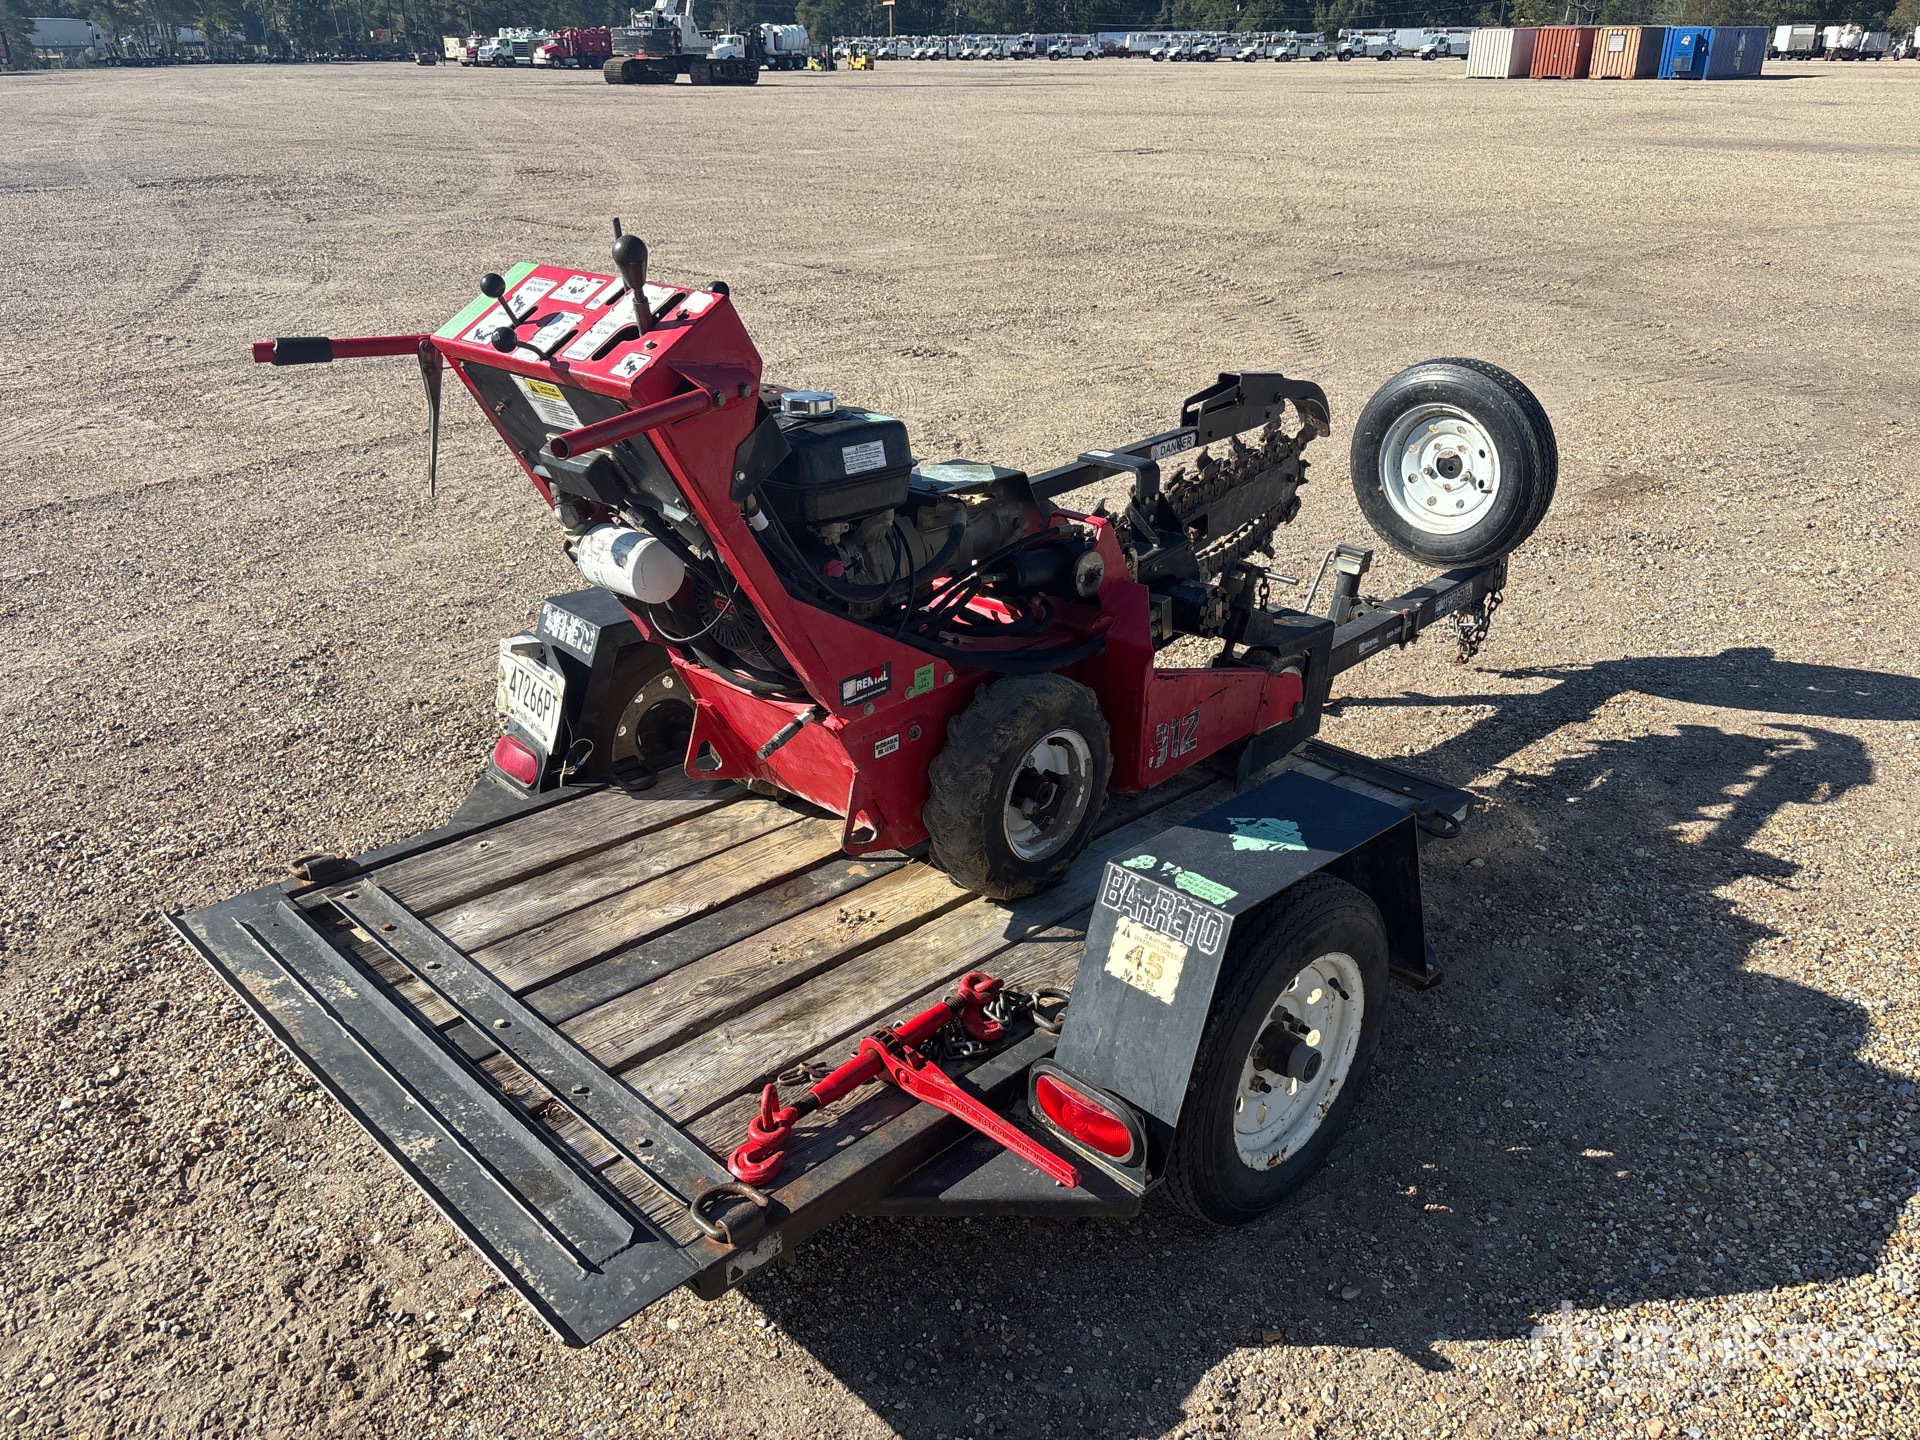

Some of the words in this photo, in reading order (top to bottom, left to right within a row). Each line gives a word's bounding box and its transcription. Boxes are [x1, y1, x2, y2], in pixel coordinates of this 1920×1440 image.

[567, 349, 588, 358] REVERSE
[856, 670, 889, 692] RENTAL
[917, 669, 932, 678] CHECK
[918, 682, 930, 691] DAILY
[509, 665, 558, 729] 47266PT
[875, 736, 899, 751] HYDRAULIC
[877, 748, 885, 756] OIL
[884, 743, 897, 753] LEVEL
[1101, 865, 1224, 955] BARRETO
[1144, 933, 1172, 950] CAUTION
[1124, 944, 1166, 980] 45
[1160, 948, 1179, 961] SPEED
